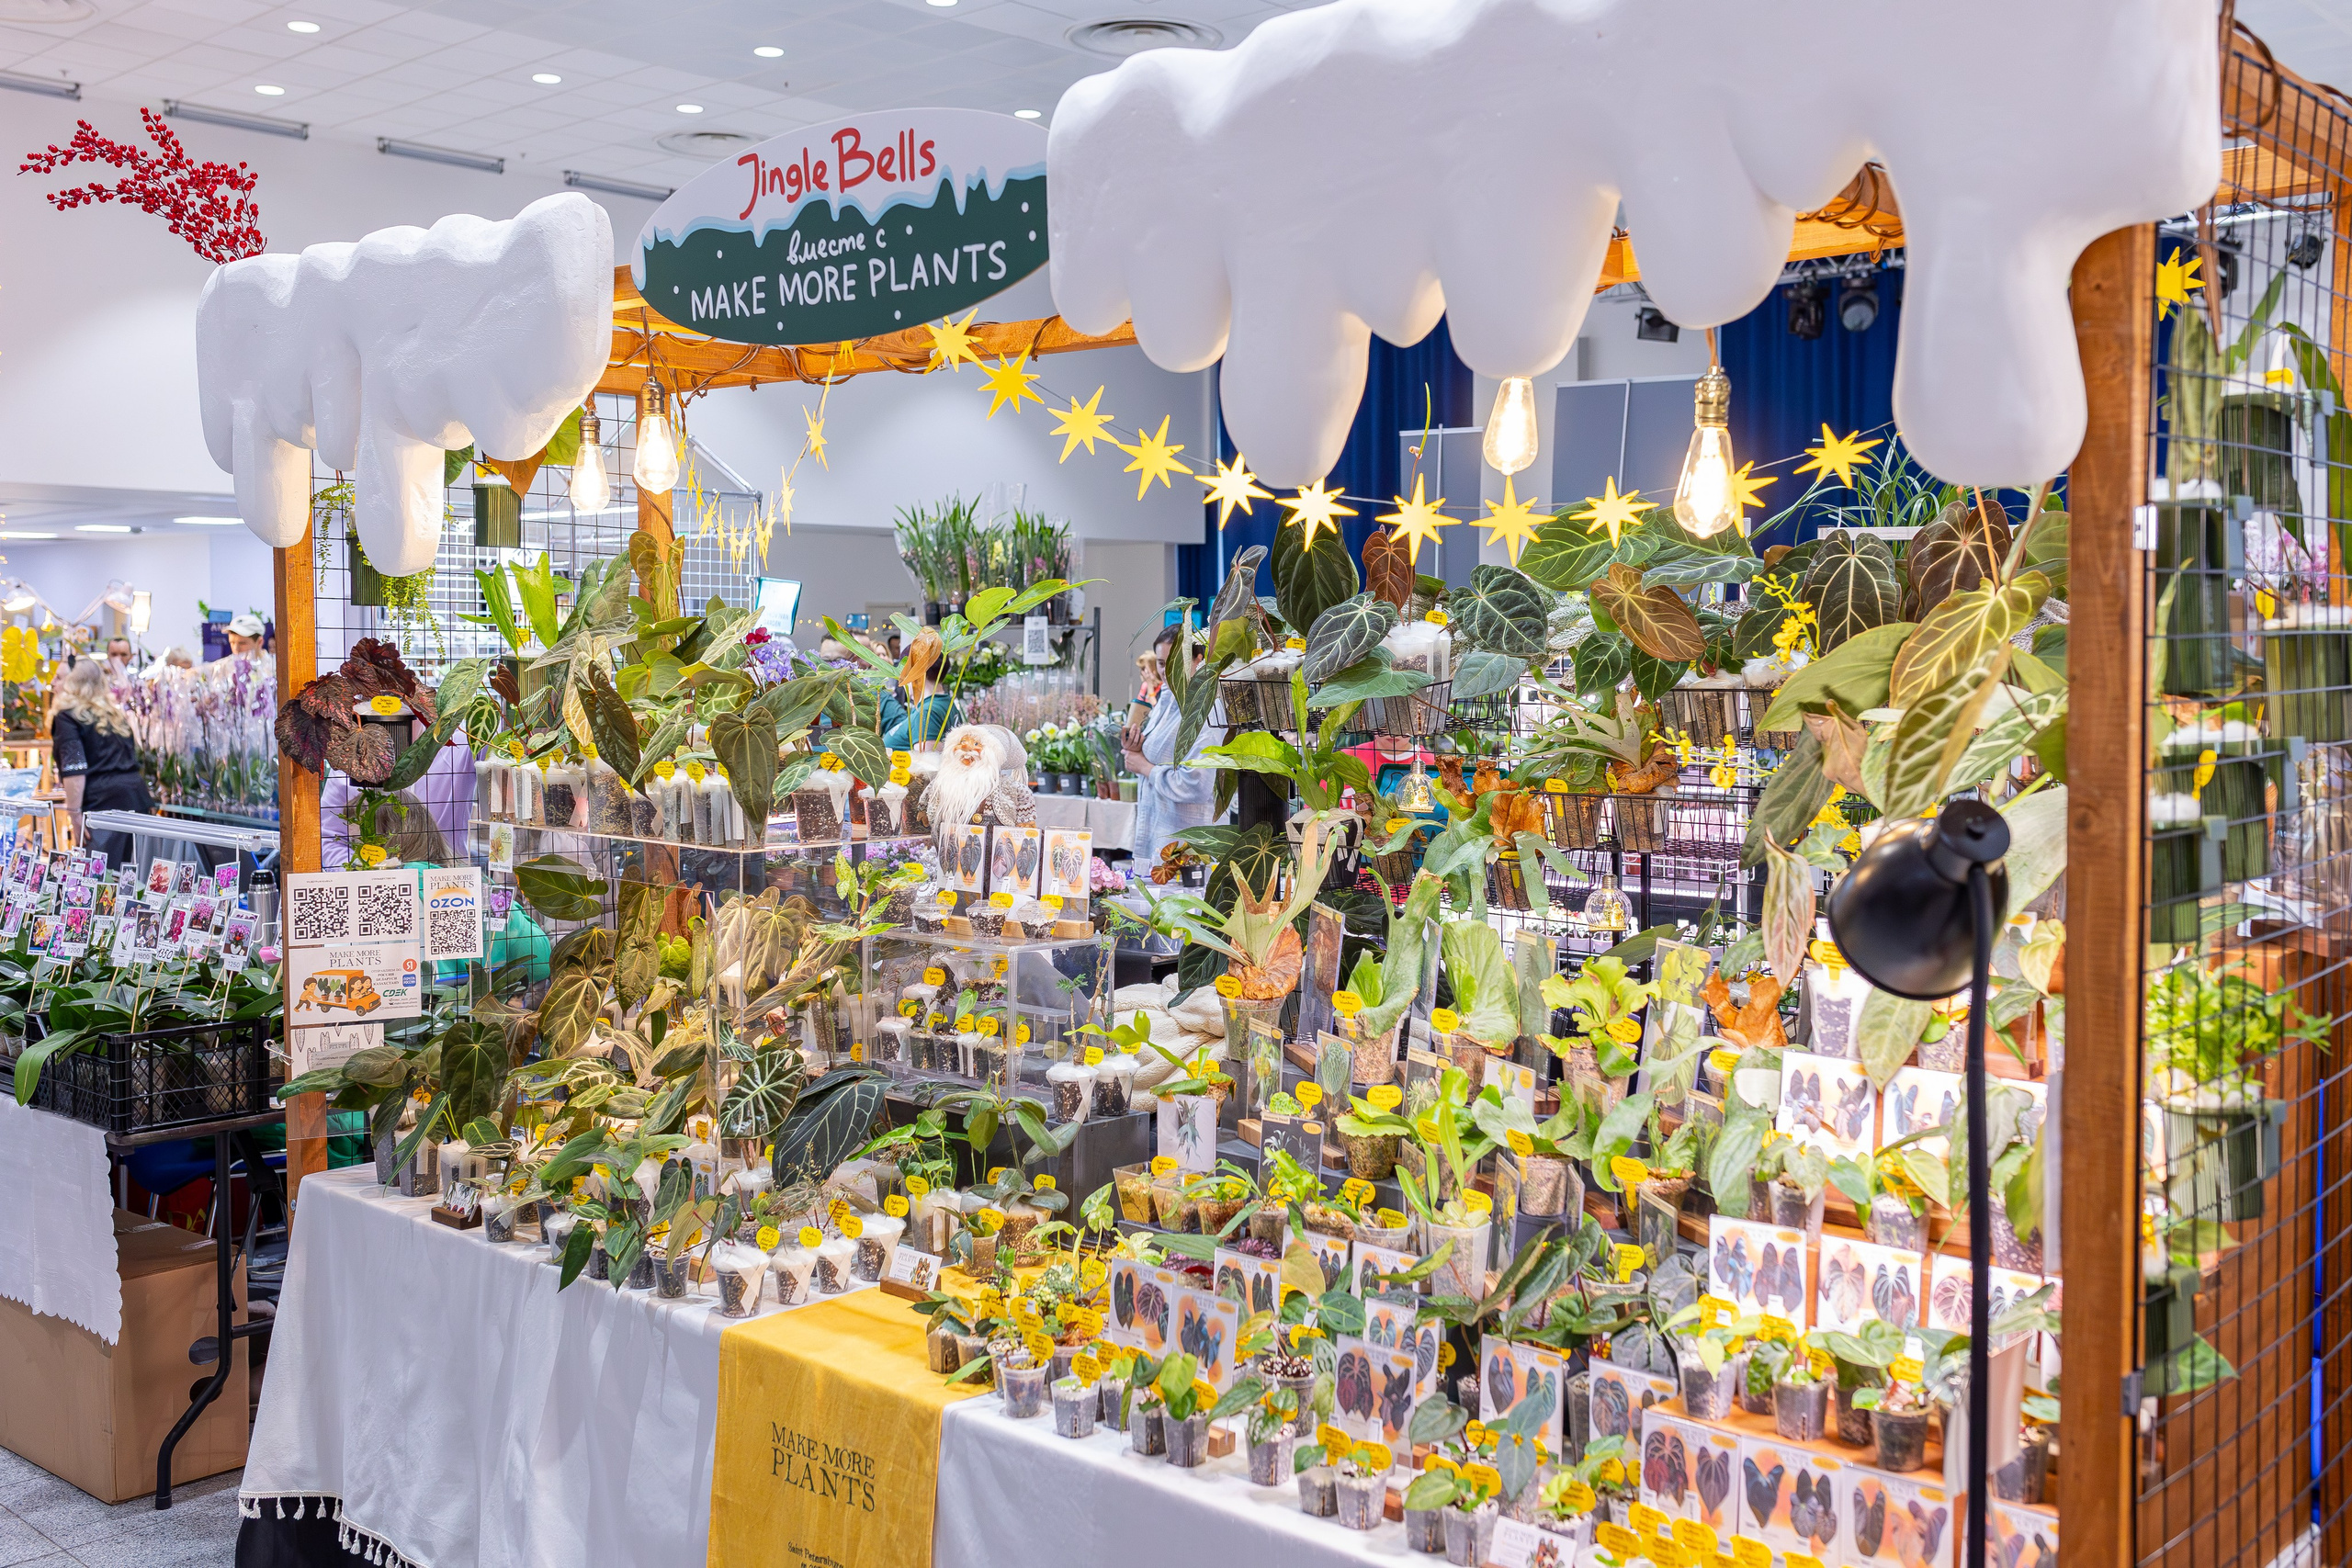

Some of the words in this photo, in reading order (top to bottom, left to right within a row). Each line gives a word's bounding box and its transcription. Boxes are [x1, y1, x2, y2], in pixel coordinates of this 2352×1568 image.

[738, 147, 829, 220] Jingle
[831, 128, 935, 194] Bells
[786, 229, 865, 265] вместе
[875, 227, 887, 249] с
[691, 276, 766, 321] MAKE
[779, 264, 857, 306] MORE
[868, 241, 1006, 298] PLANTS
[452, 874, 474, 882] MORE
[430, 881, 475, 890] PLANTS
[430, 897, 474, 908] OZON
[158, 948, 174, 960] 1350
[329, 951, 355, 959] MAKE
[356, 949, 381, 958] MORE
[330, 956, 382, 968] PLANTS
[382, 988, 409, 997] CDEK
[771, 1421, 819, 1461] MAKE
[822, 1442, 876, 1480] MORE
[771, 1446, 876, 1512] PLANTS
[787, 1540, 803, 1558] Saint
